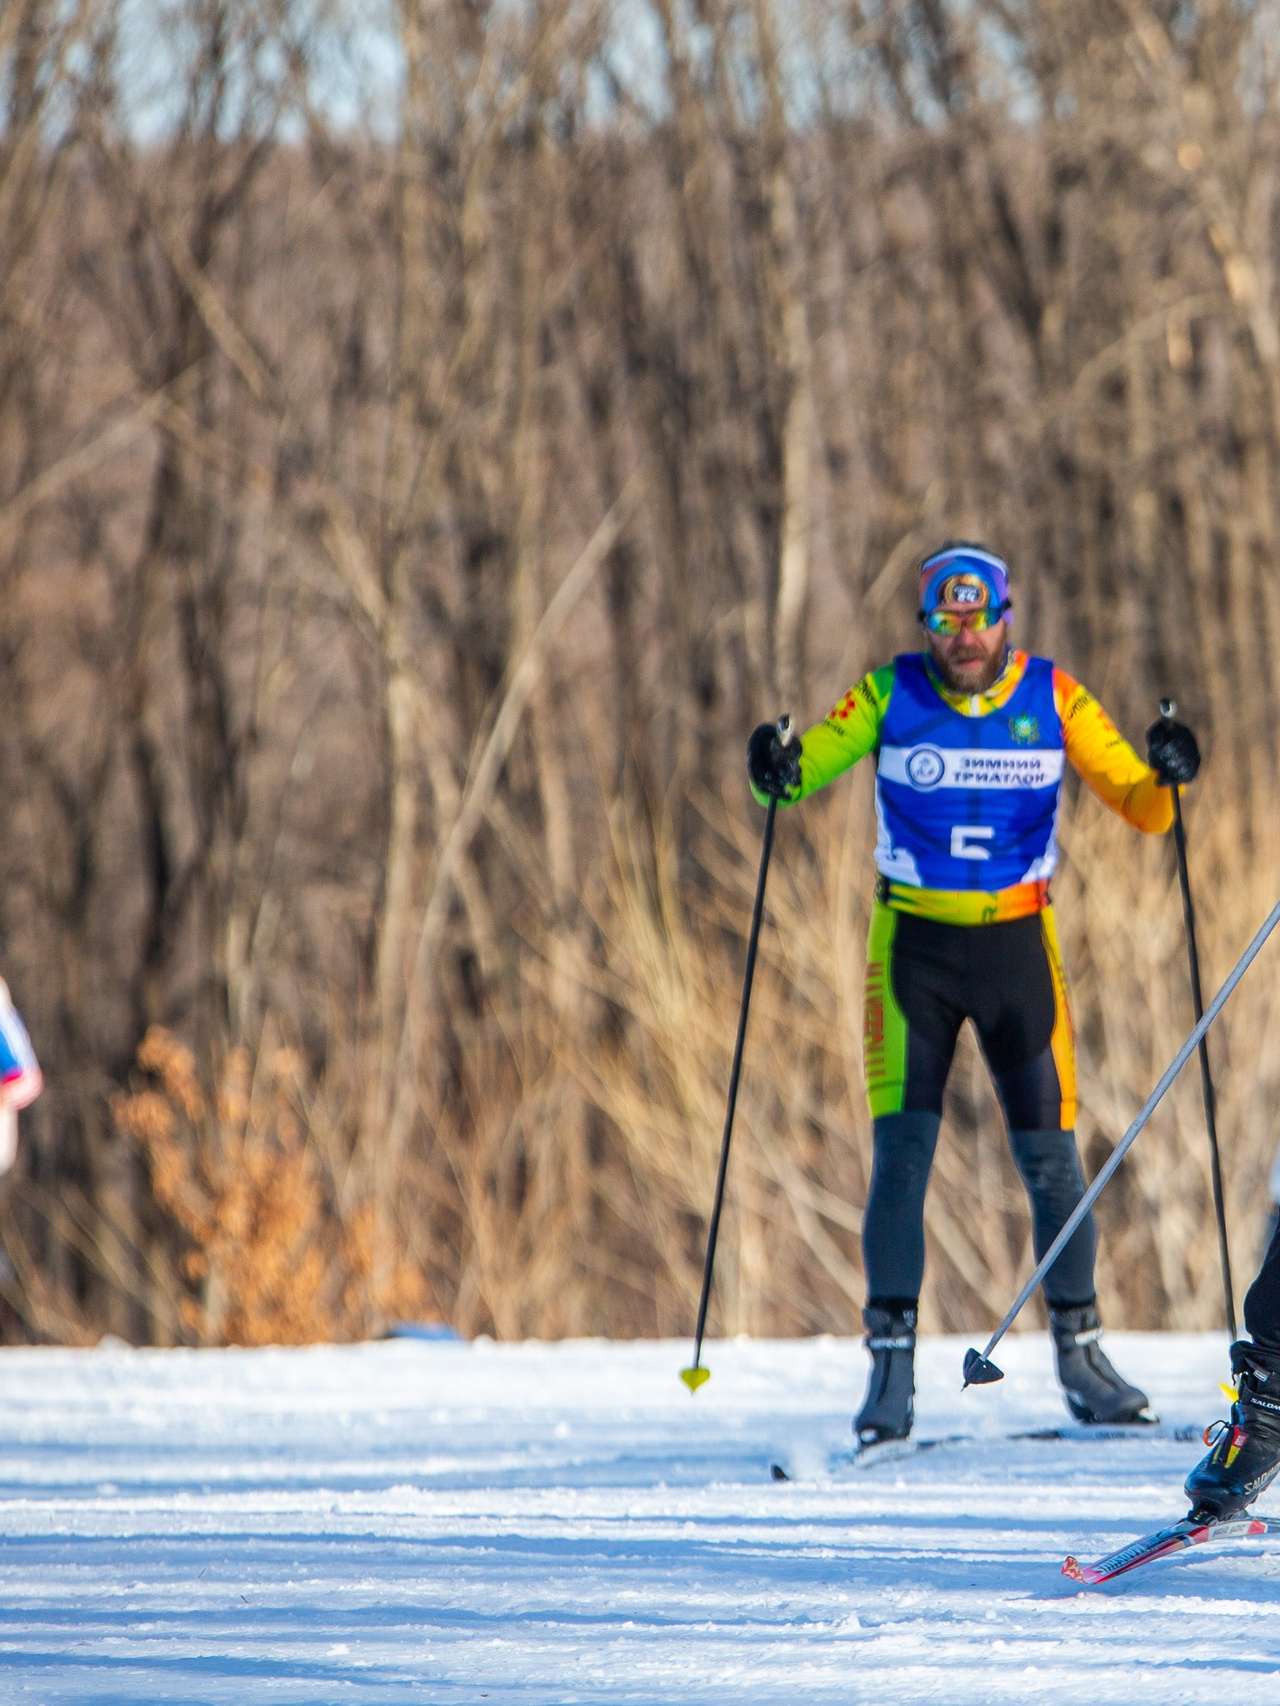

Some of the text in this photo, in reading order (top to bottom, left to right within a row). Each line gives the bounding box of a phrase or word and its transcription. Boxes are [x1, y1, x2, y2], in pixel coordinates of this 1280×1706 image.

[962, 755, 1042, 769] ЗИМНИЙ
[953, 772, 1045, 784] ТРИАТЛОН
[950, 824, 995, 861] 5
